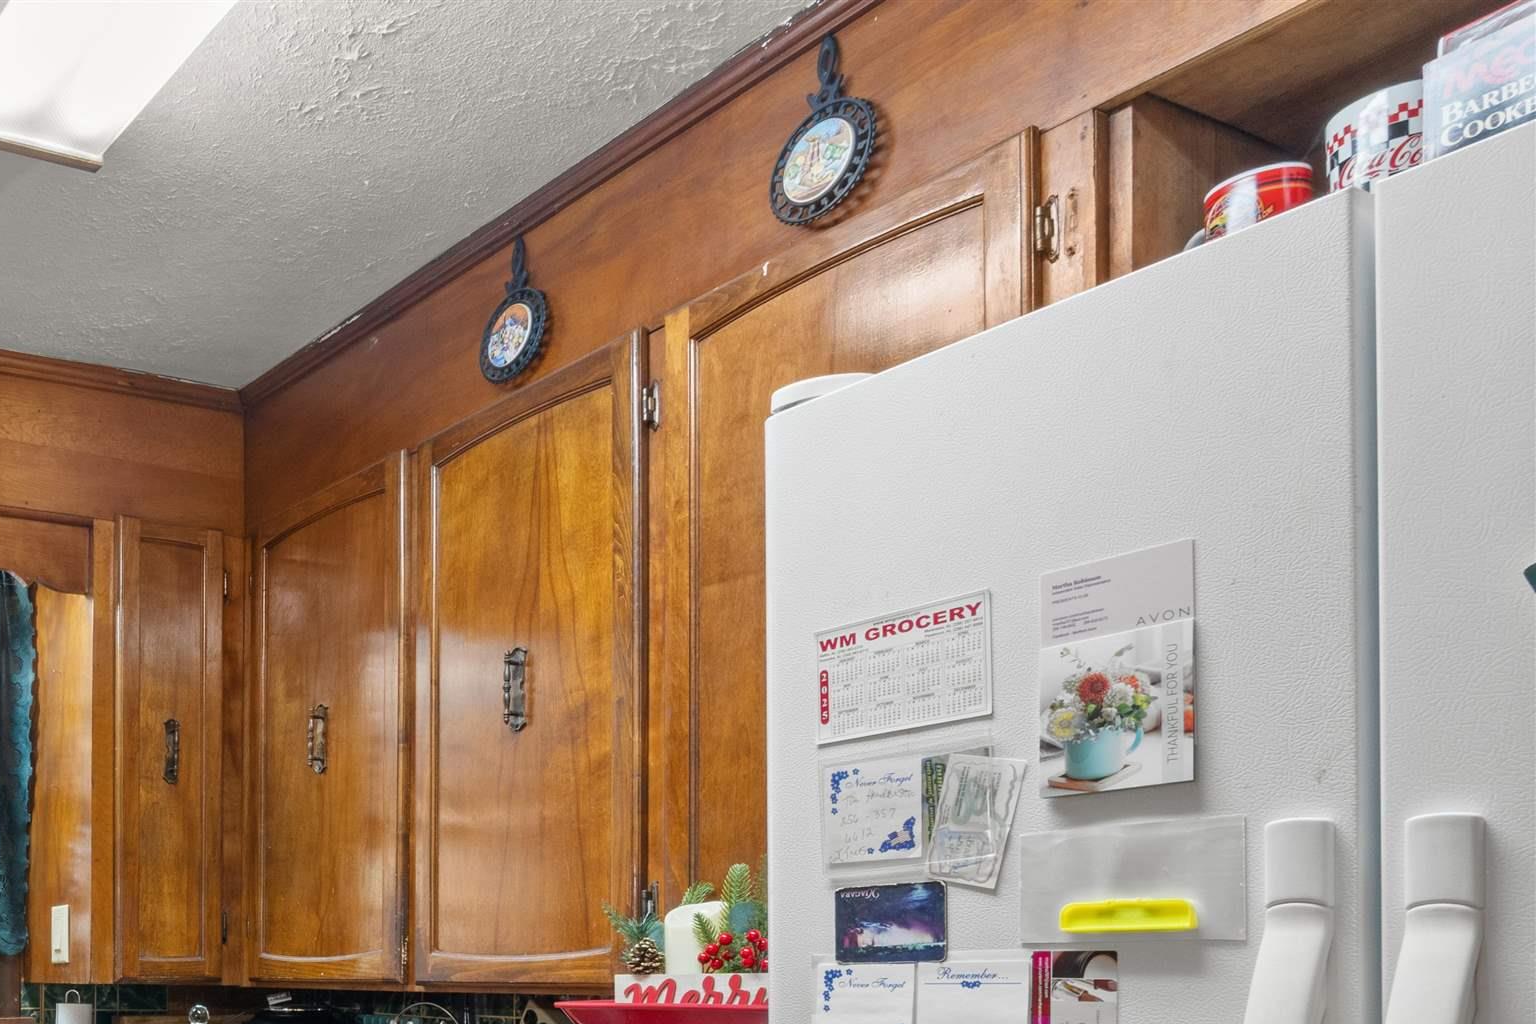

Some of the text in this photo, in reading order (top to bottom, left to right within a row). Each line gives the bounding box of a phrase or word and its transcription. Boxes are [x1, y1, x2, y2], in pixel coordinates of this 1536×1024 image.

[819, 633, 856, 651] WM
[865, 601, 982, 641] GROCERY
[1136, 606, 1190, 626] AVON
[820, 672, 828, 720] 2025
[1167, 643, 1179, 763] THANKFUL FOR YOU
[846, 773, 914, 789] Never Forget
[839, 976, 907, 993] Never Forget
